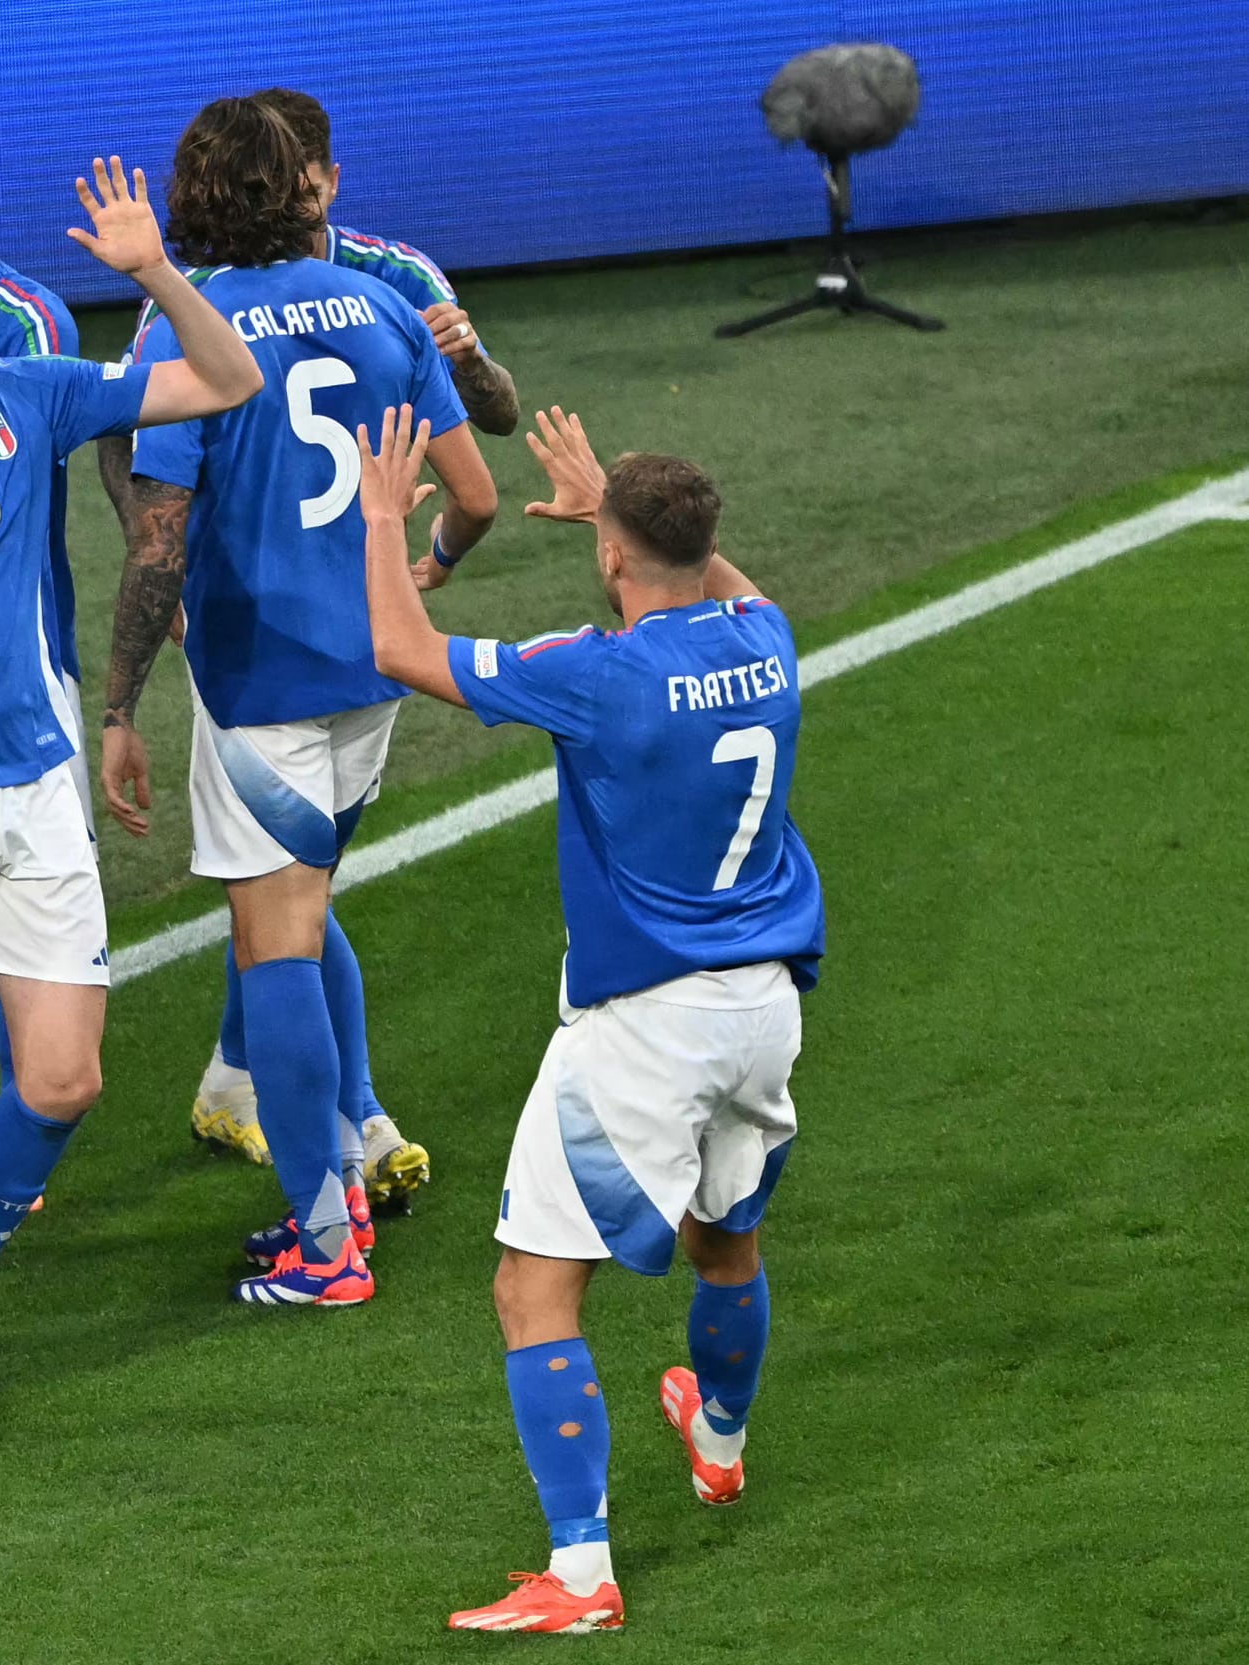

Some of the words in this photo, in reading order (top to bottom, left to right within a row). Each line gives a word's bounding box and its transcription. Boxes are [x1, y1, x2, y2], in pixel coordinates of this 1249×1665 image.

[232, 296, 377, 342] CALAFIORI
[286, 357, 362, 530] 5
[668, 655, 788, 712] FRATTESI
[711, 725, 777, 891] 7
